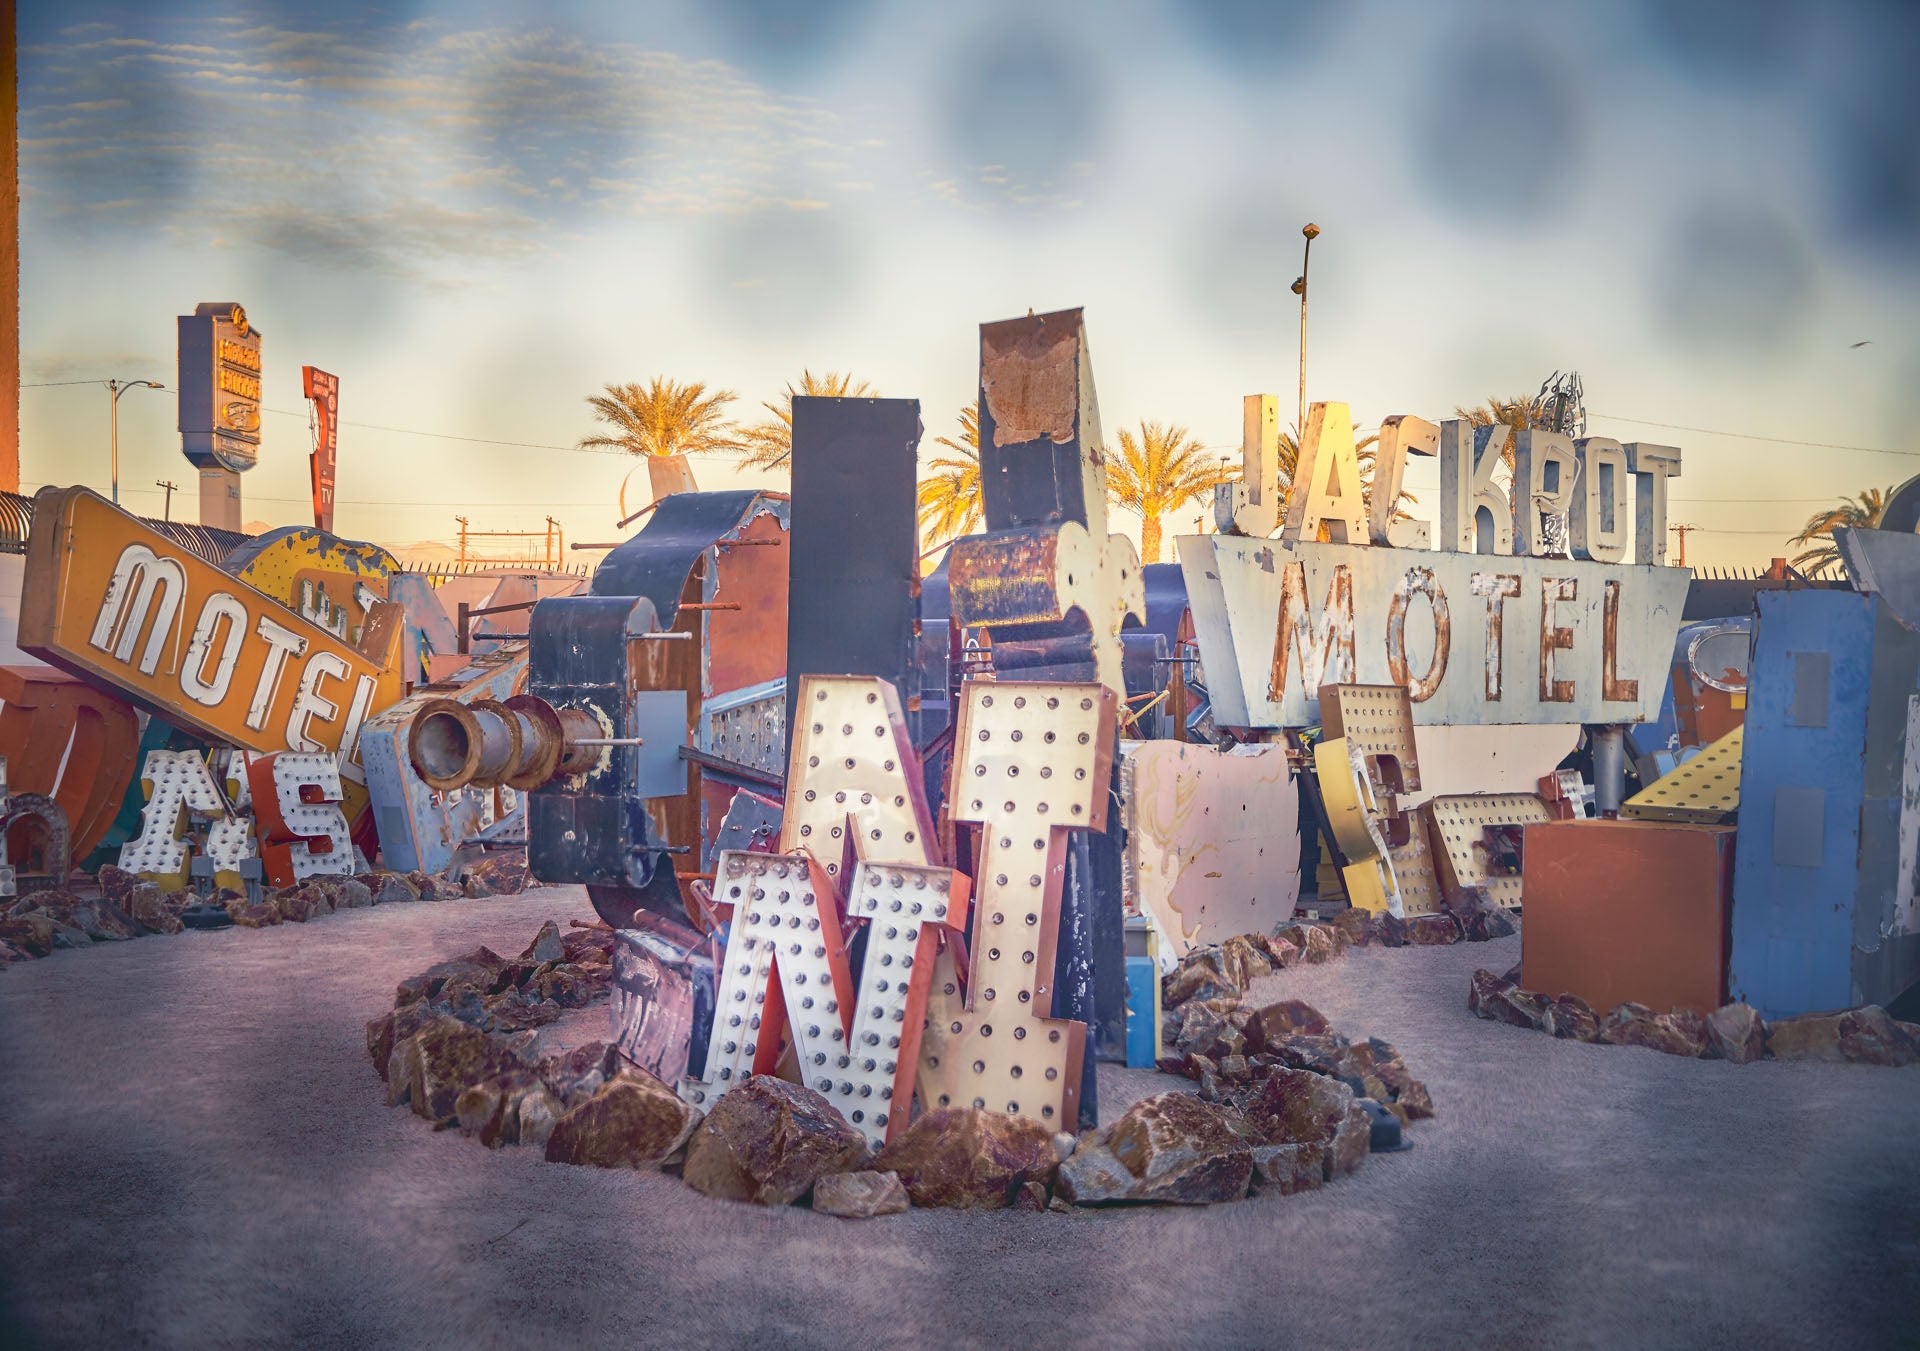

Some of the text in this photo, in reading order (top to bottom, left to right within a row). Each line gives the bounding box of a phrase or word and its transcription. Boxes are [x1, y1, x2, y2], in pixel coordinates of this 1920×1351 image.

[321, 487, 332, 504] TV
[1214, 393, 1682, 566] JACKPOT
[88, 543, 378, 787] MOTEL
[1268, 560, 1639, 704] MOTEL
